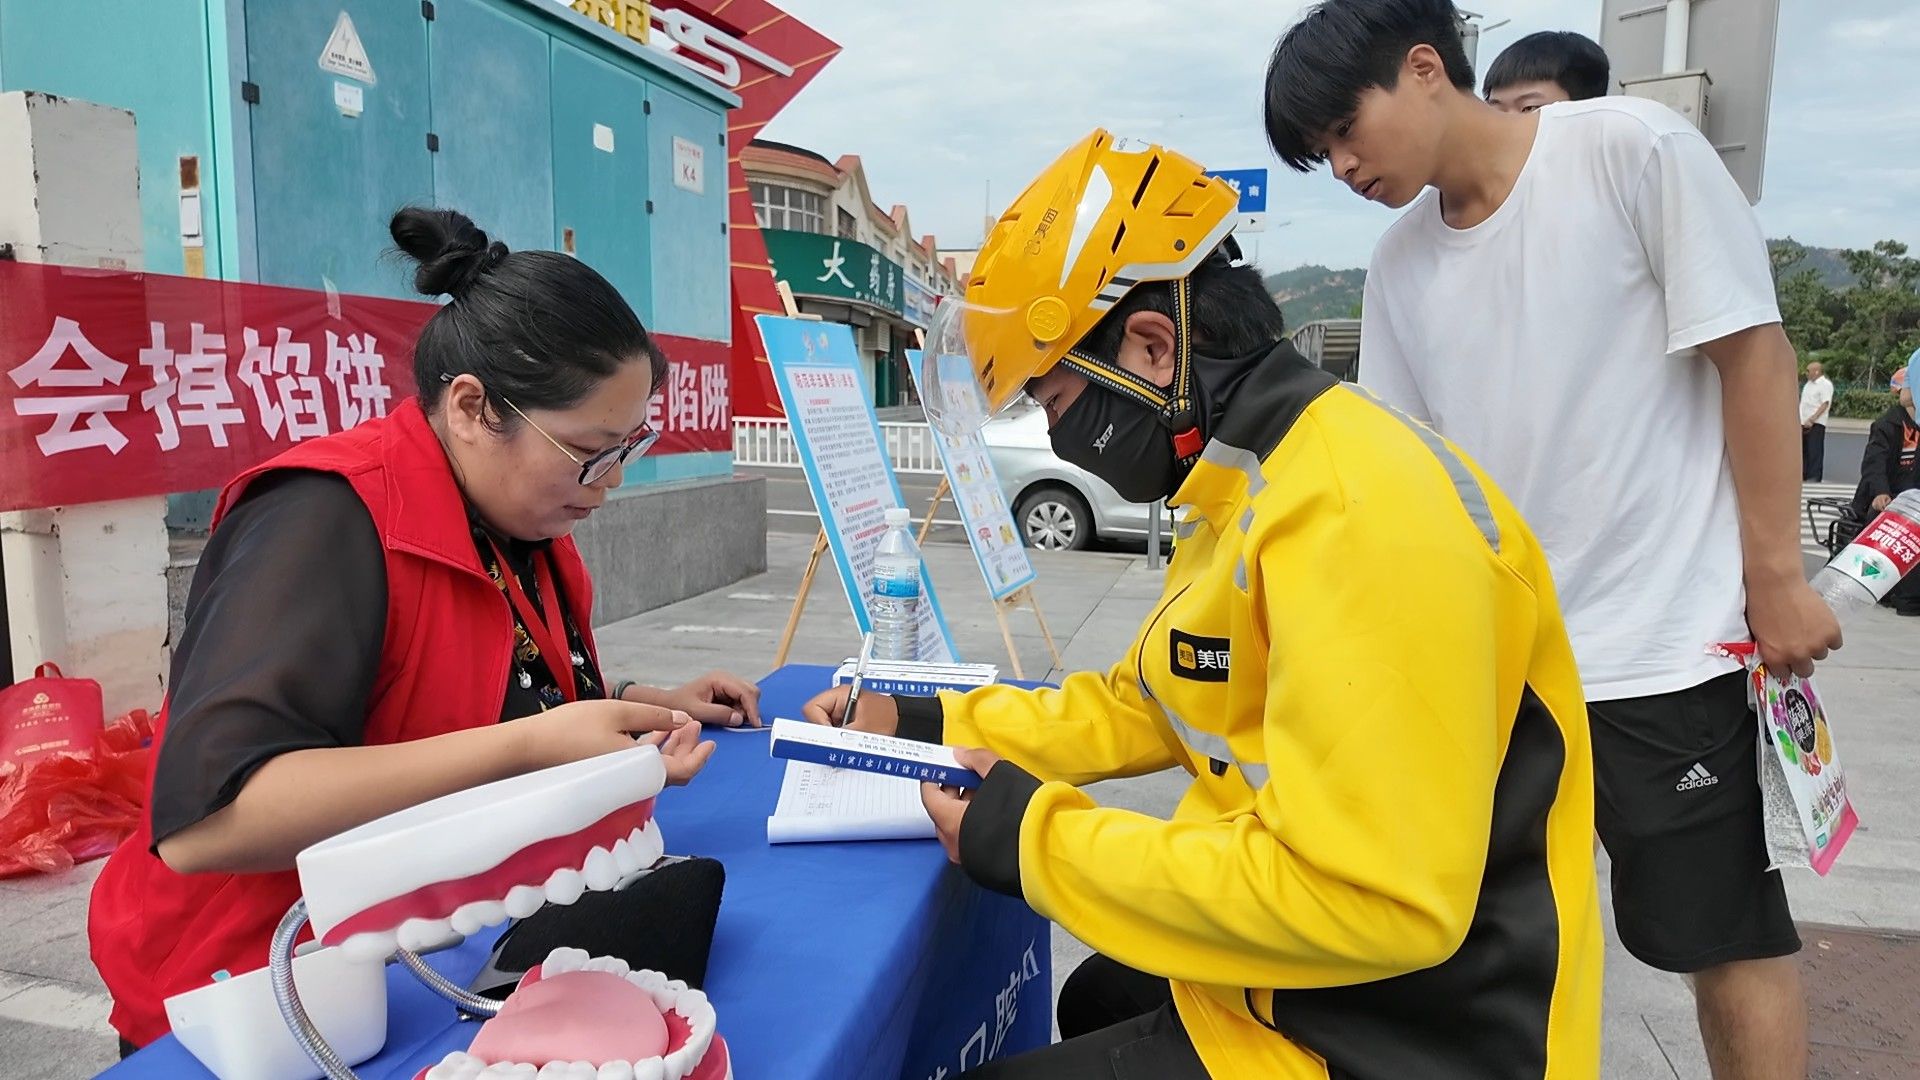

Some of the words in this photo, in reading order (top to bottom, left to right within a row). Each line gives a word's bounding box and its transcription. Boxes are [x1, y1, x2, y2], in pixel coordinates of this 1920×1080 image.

[683, 163, 696, 181] K4
[1034, 208, 1058, 240] 美团
[8, 316, 391, 456] 会掉馅饼
[1867, 527, 1915, 565] 农夫山泉
[1197, 649, 1230, 669] 美团
[1676, 776, 1719, 791] adidas
